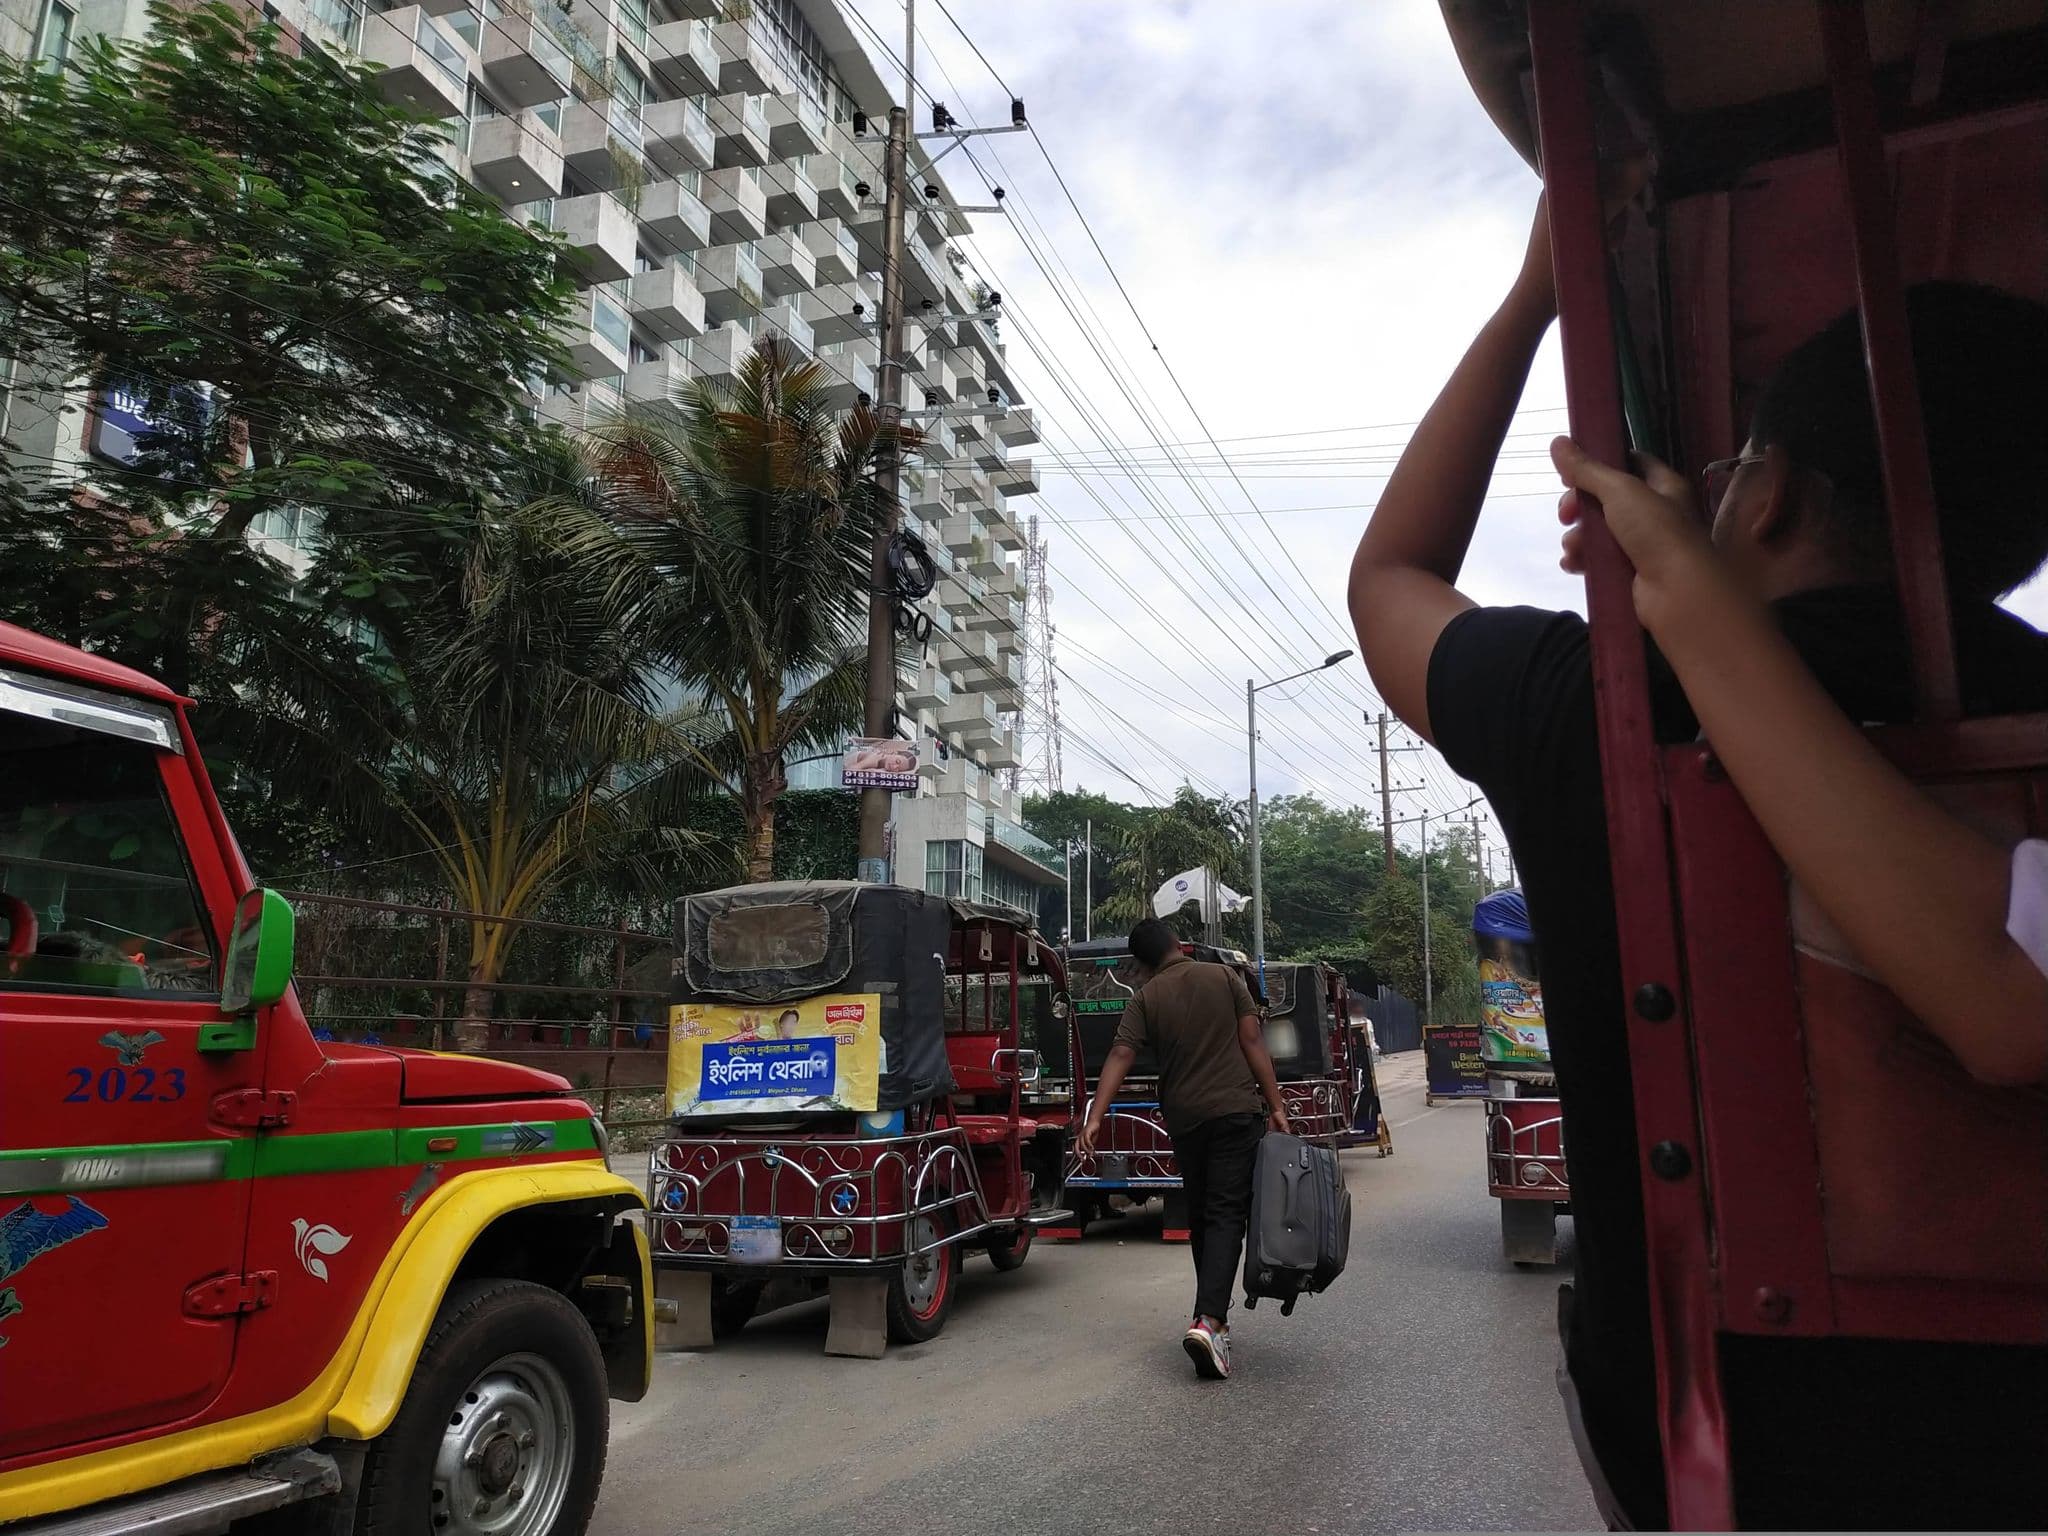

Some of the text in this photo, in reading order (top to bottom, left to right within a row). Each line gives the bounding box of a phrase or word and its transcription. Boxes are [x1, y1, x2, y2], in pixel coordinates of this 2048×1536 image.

[709, 1051, 829, 1085] ইংলিশ থেরাপি
[63, 1068, 187, 1103] 2023
